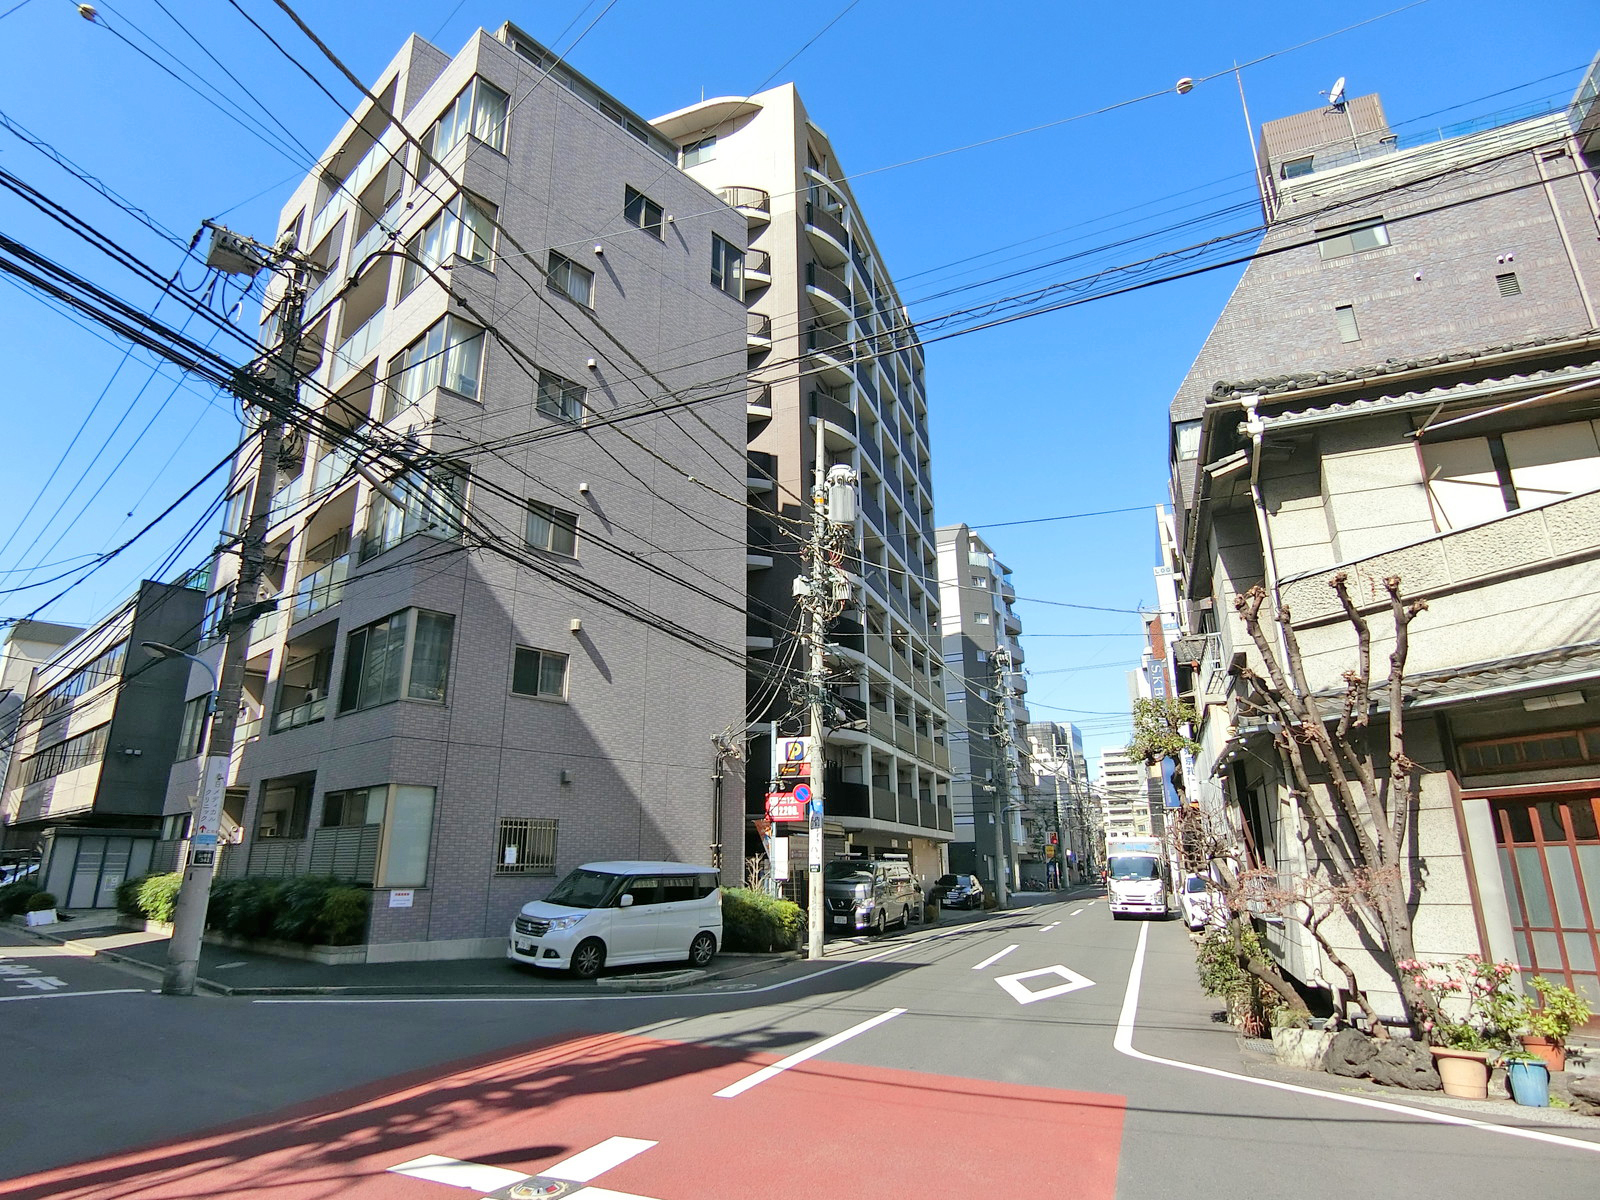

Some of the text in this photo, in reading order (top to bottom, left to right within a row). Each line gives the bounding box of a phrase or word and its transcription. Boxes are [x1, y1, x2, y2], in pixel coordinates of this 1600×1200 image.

[200, 789, 212, 822] クリニック
